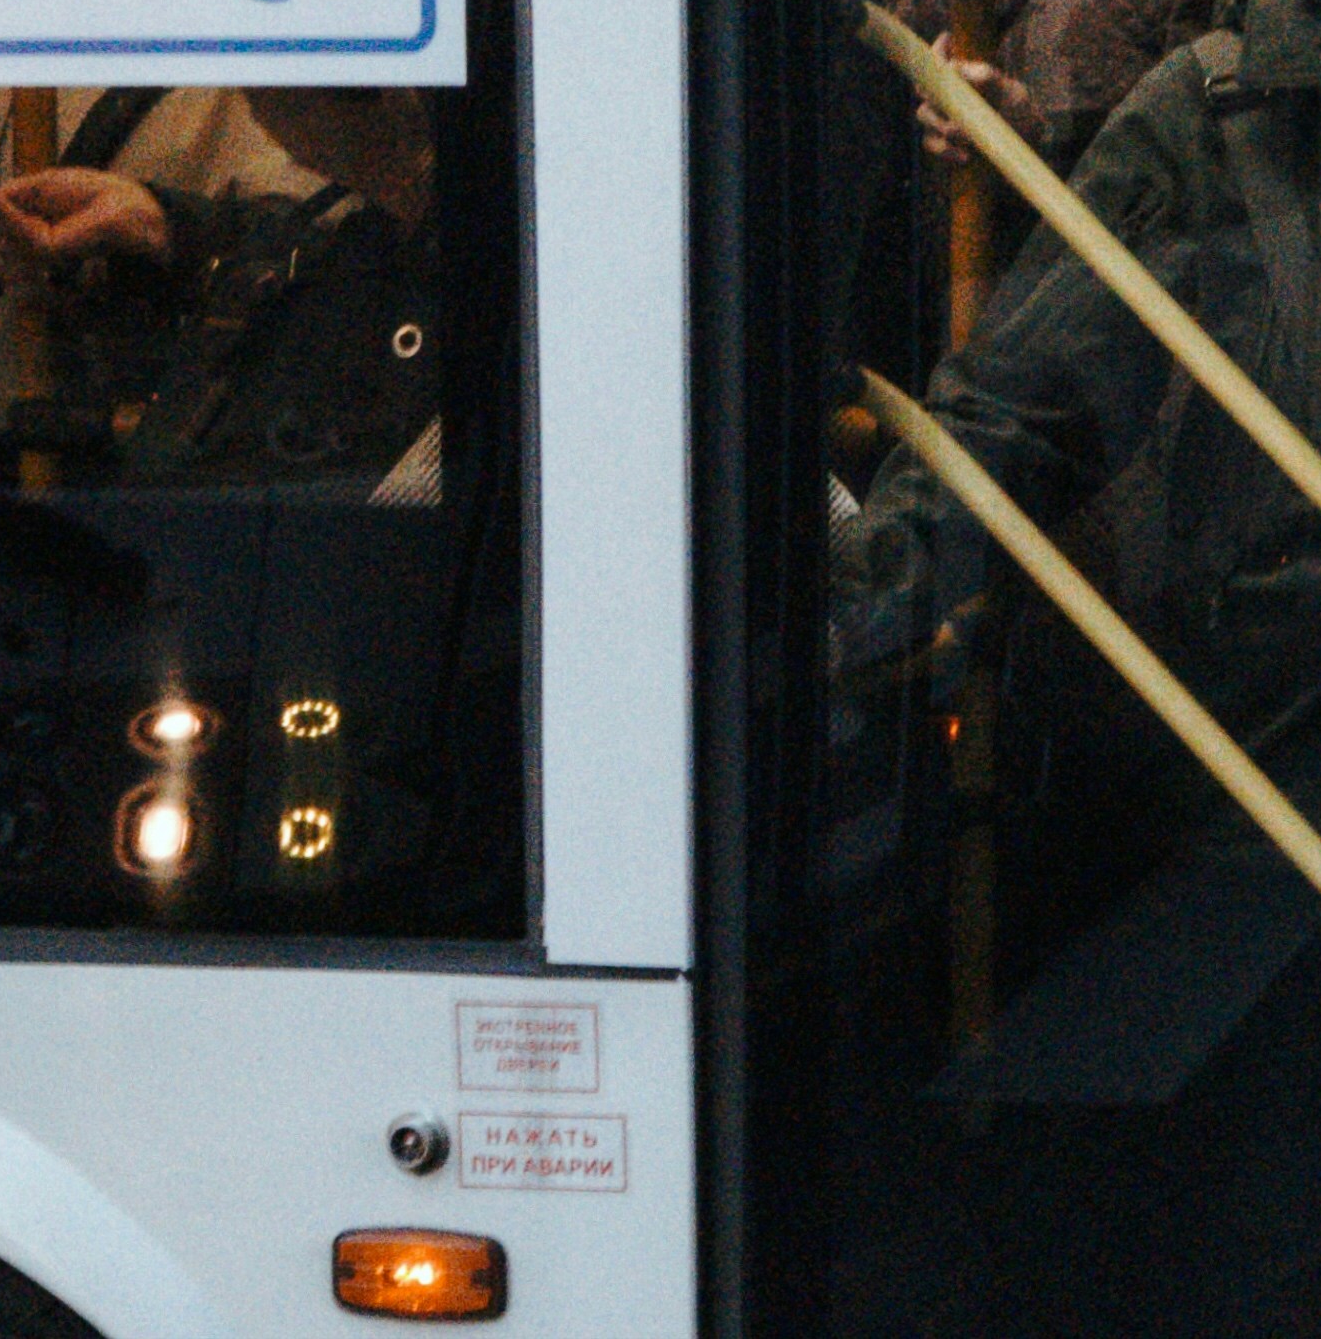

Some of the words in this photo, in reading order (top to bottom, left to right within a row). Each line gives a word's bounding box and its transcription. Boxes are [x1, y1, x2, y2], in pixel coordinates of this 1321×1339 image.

[485, 1127, 598, 1148] НАЖАТЬ
[471, 1155, 517, 1175] ПРИ
[523, 1156, 614, 1177] АВАРИИ
